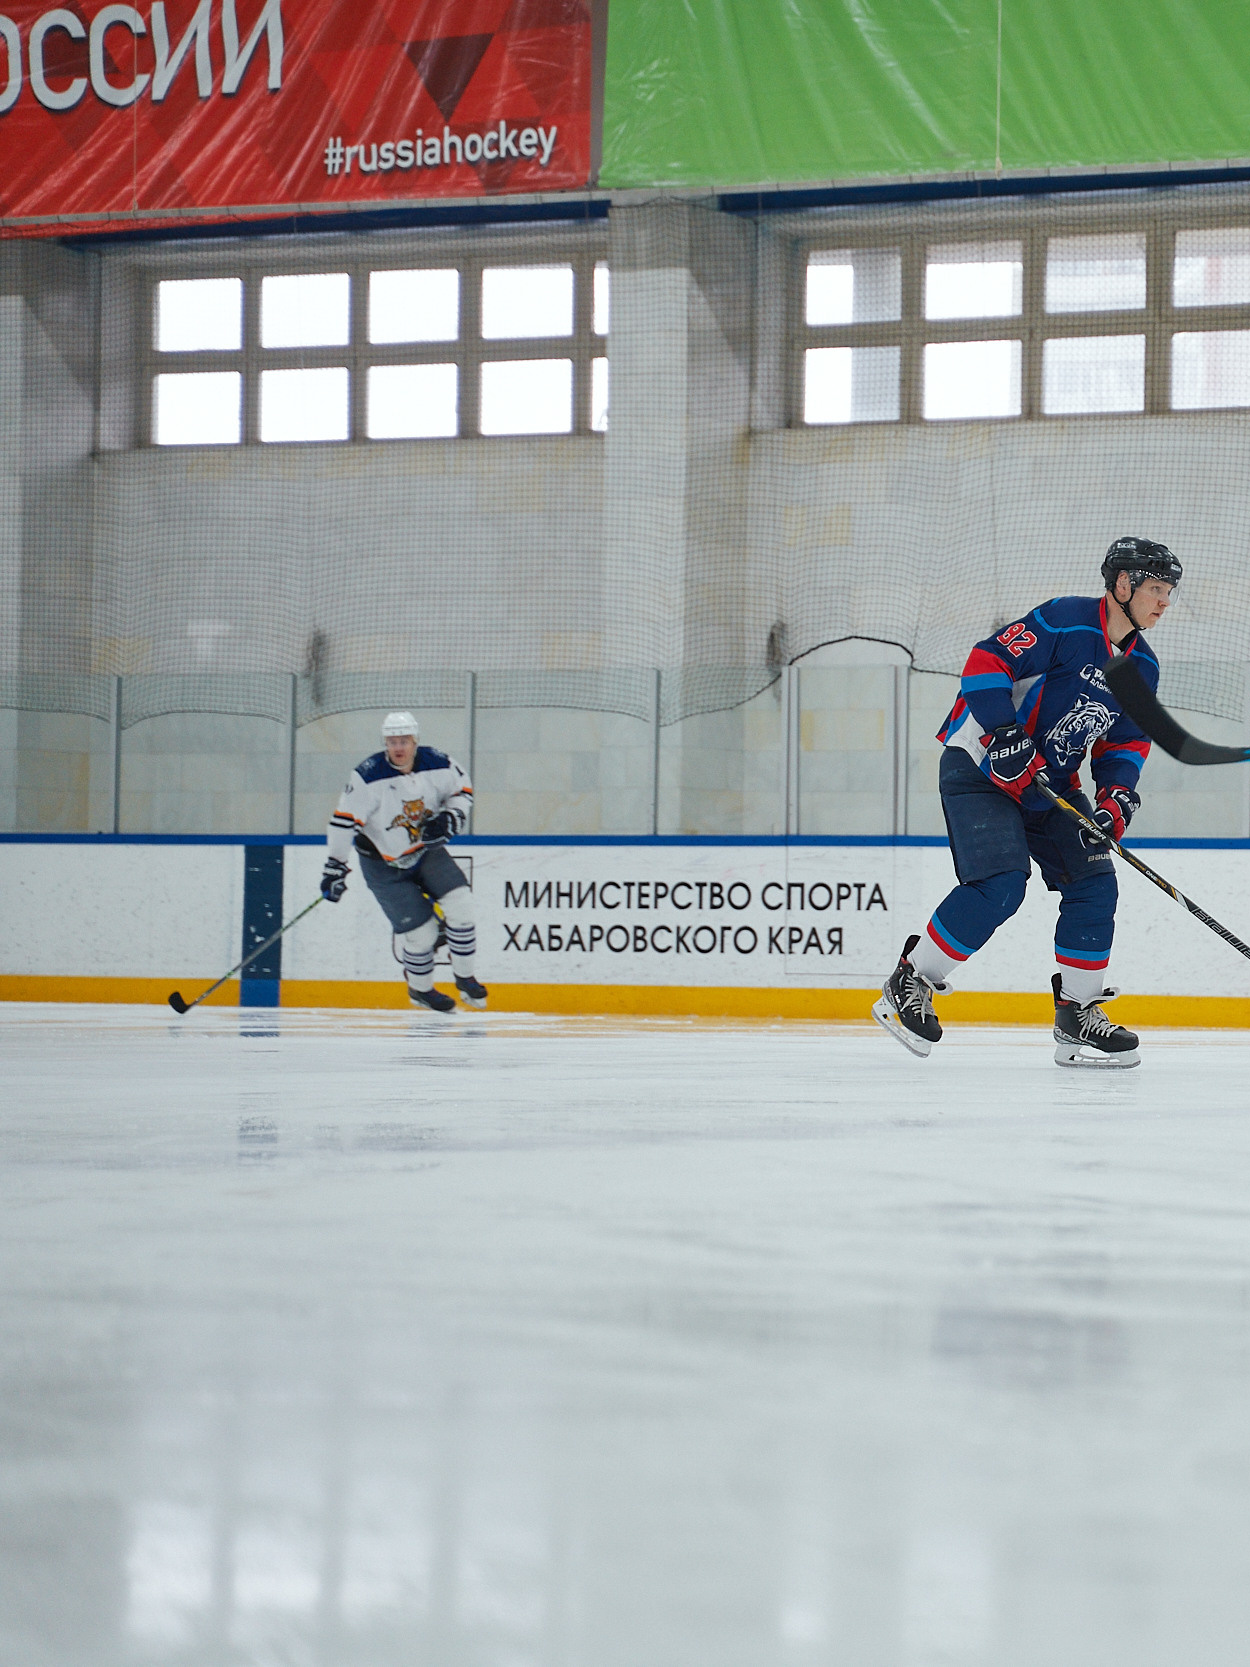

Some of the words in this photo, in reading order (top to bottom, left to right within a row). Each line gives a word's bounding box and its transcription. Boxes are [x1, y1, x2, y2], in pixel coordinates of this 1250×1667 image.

[324, 120, 557, 176] #russiahockey
[1087, 852, 1111, 863] BAUE
[504, 881, 752, 911] МИНИСТЕРСТВО
[761, 882, 888, 911] СПОРТА
[503, 923, 758, 954] ХАБАРОВСКОГО
[768, 926, 843, 955] КРАЯ
